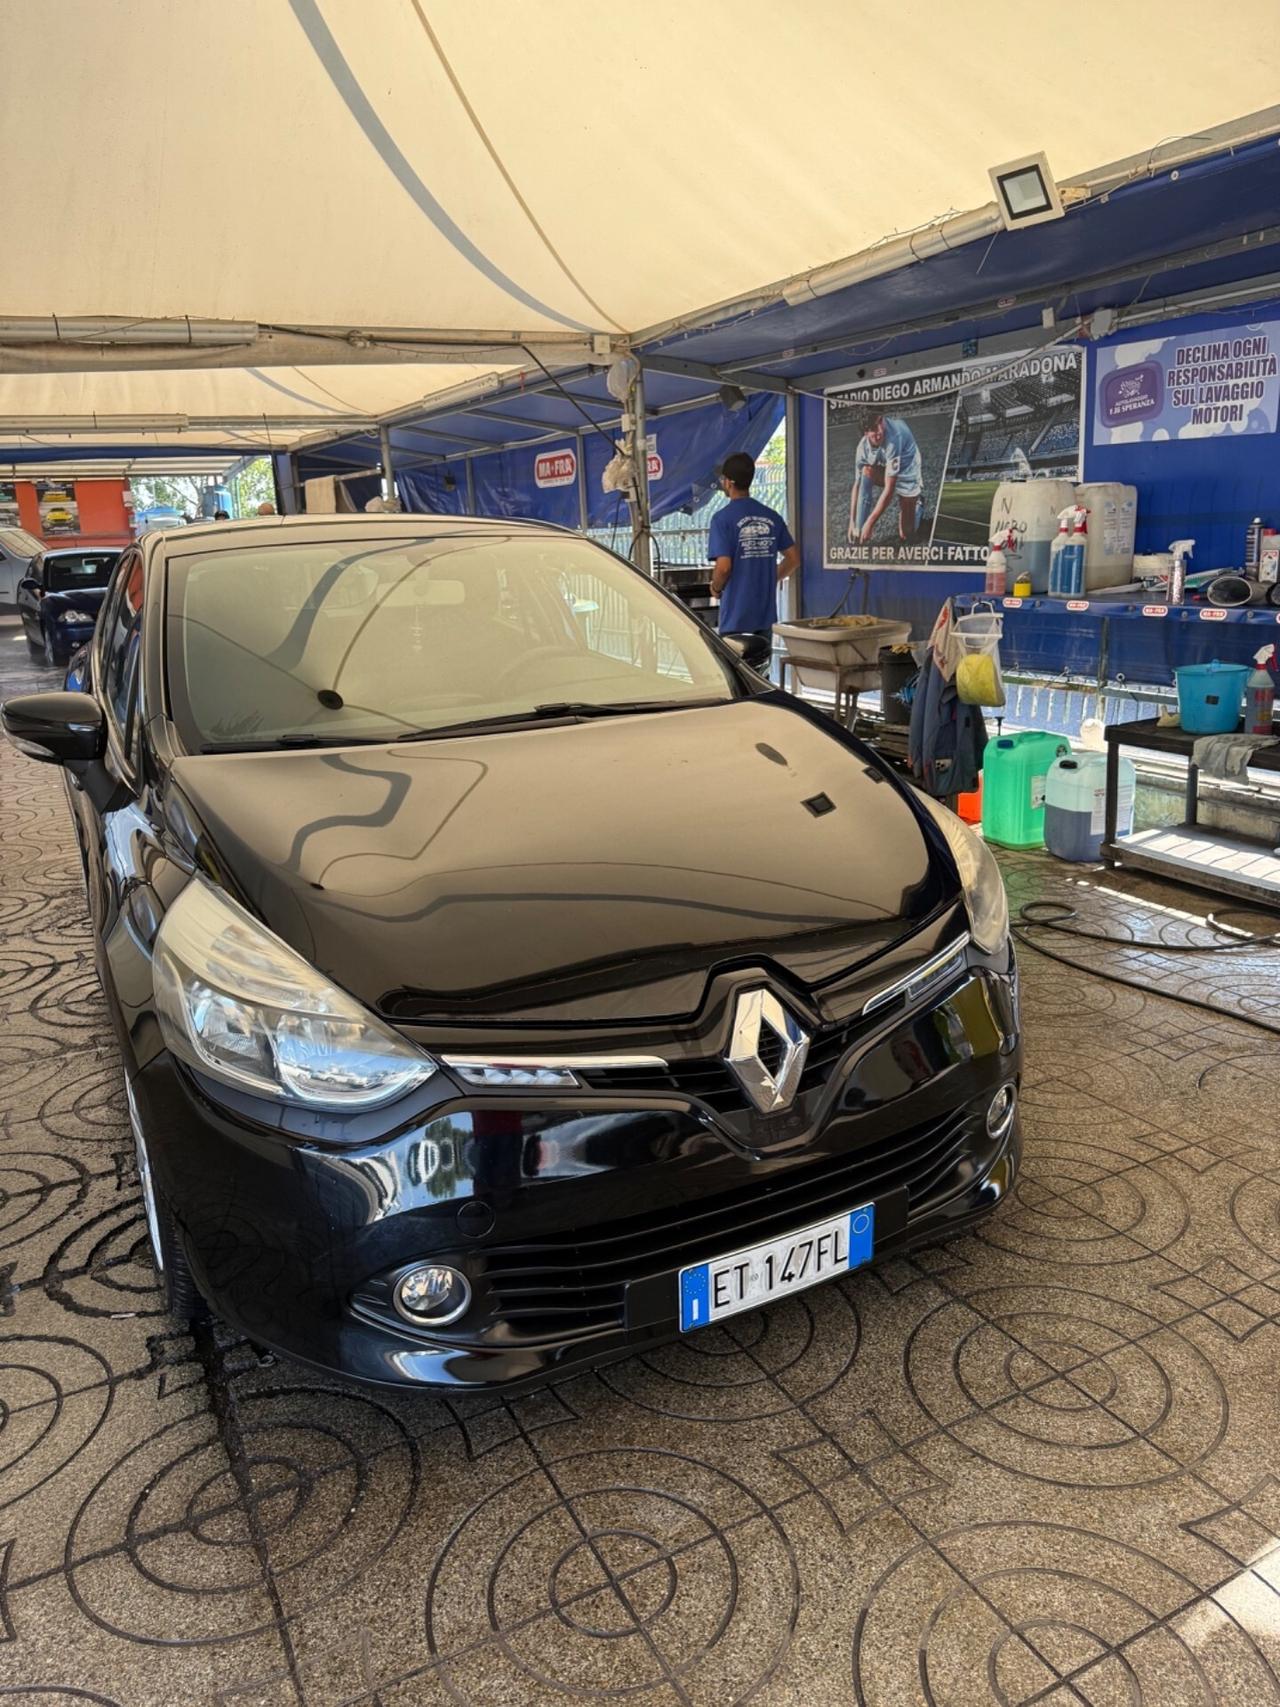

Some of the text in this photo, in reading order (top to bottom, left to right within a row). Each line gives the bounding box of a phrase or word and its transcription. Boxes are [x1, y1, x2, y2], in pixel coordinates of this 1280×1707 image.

[1177, 337, 1267, 366] DECLINA OGNI
[1167, 356, 1277, 387] RESPONSABILITÀ
[873, 383, 910, 402] DIEGO
[1173, 381, 1264, 406] SUL LAVAGGIO
[1192, 404, 1244, 425] MOTORI
[830, 546, 990, 561] GRAZIE PER AVERCI FATTO
[713, 1230, 848, 1309] ET 147FL
